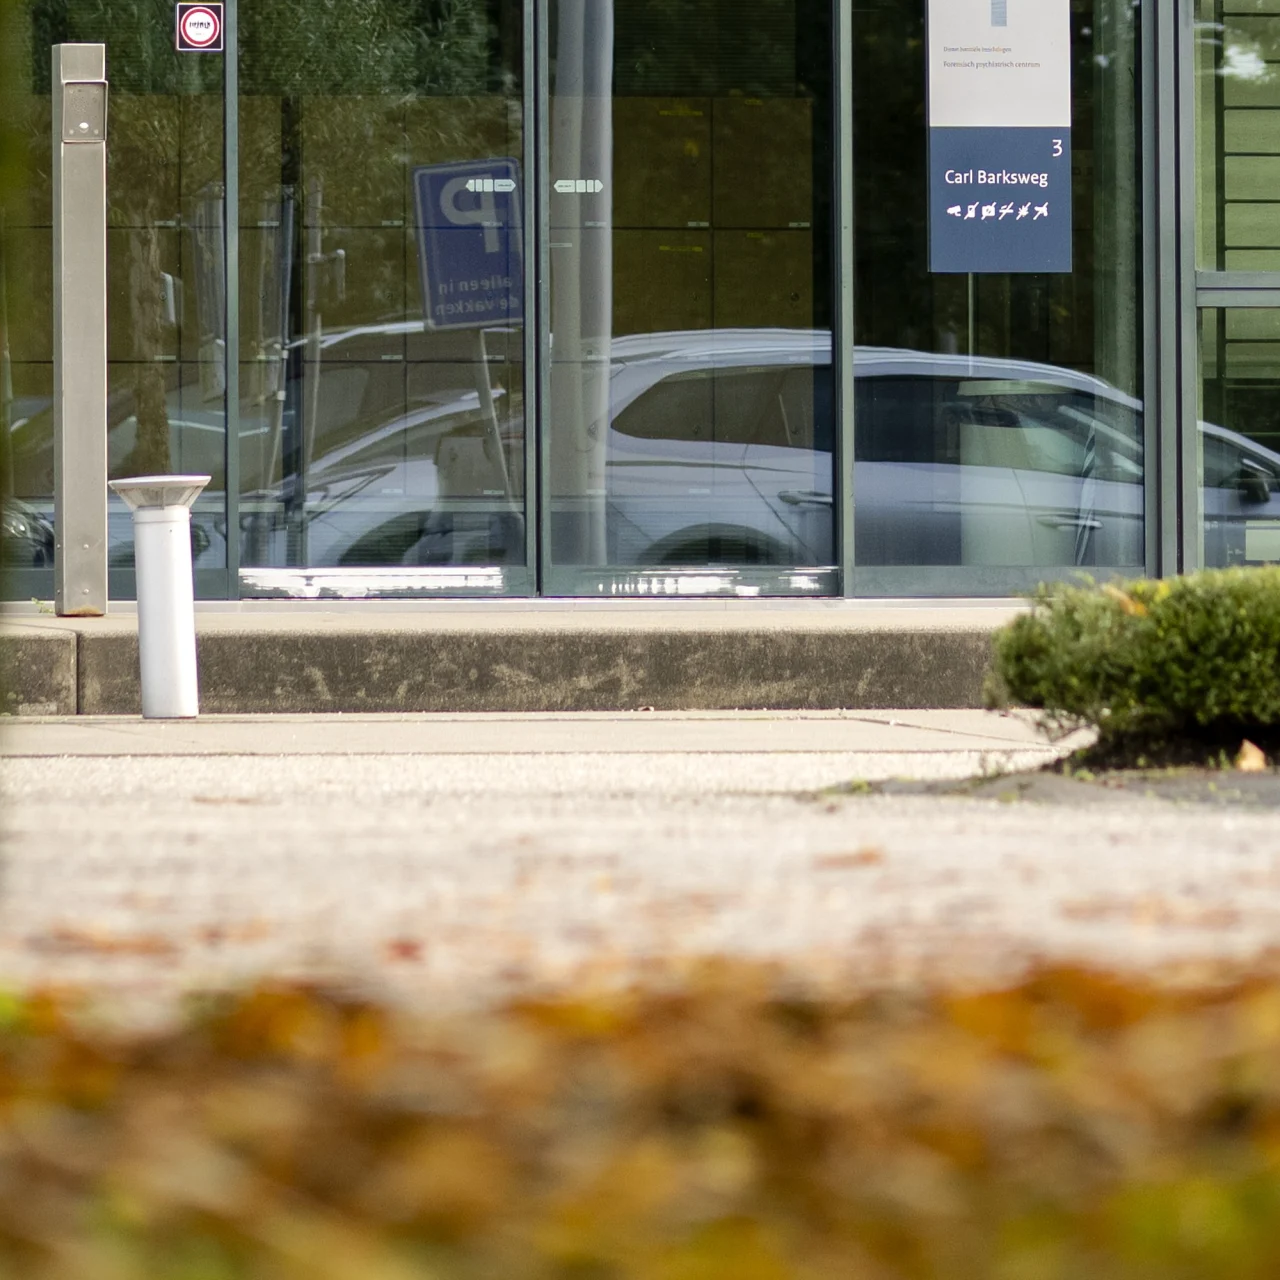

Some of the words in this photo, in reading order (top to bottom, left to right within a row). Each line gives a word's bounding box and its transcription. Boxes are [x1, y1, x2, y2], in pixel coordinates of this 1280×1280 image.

[1052, 139, 1063, 157] 3
[944, 169, 973, 184] Carl
[977, 169, 1048, 188] Barksweg
